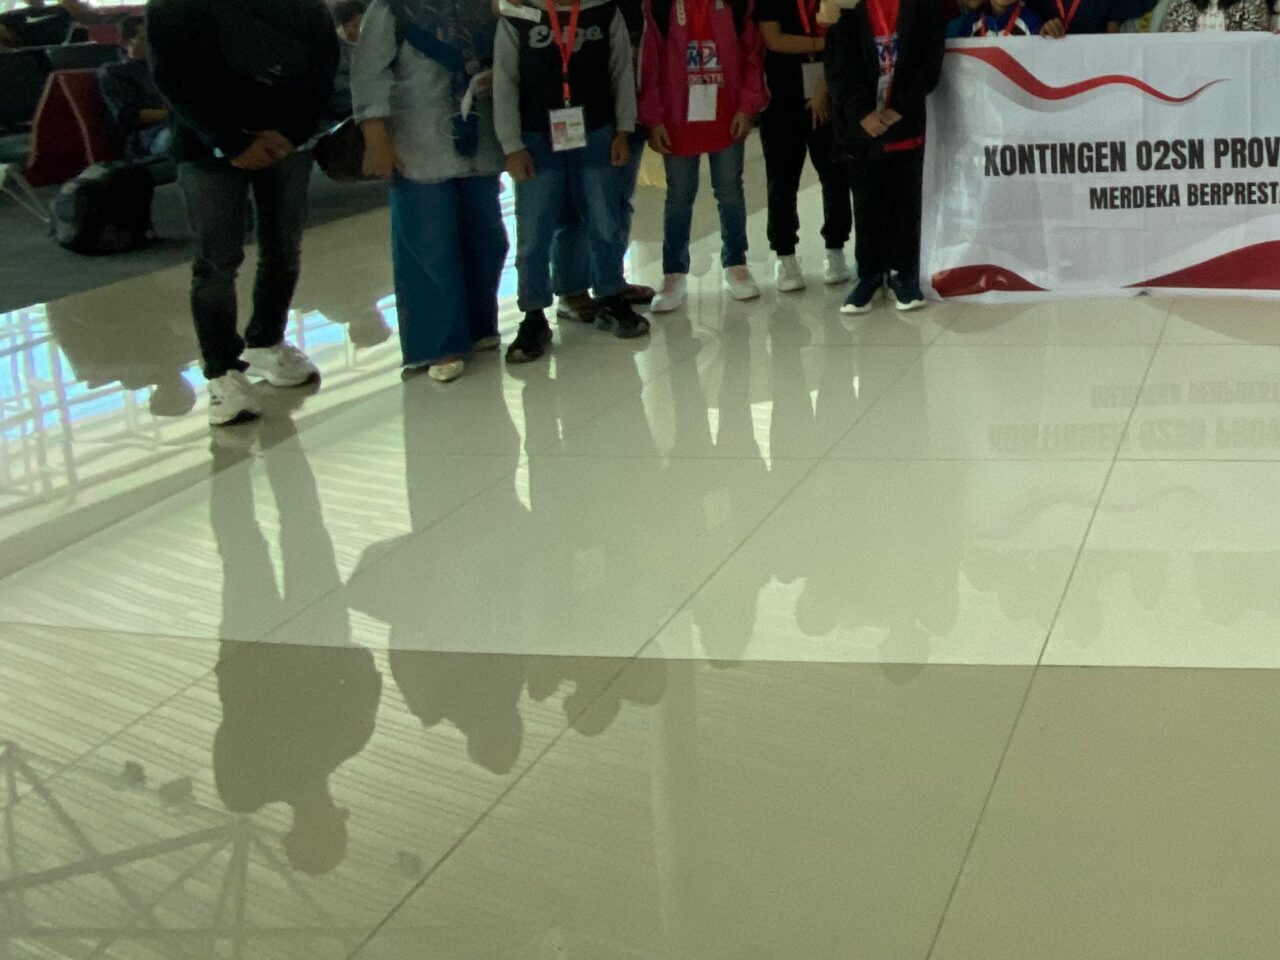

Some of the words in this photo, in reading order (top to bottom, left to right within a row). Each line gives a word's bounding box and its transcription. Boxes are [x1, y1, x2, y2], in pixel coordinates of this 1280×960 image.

[984, 141, 1127, 177] KONTINGEN
[1136, 138, 1203, 172] O2SN
[1089, 184, 1181, 210] MERDEKA
